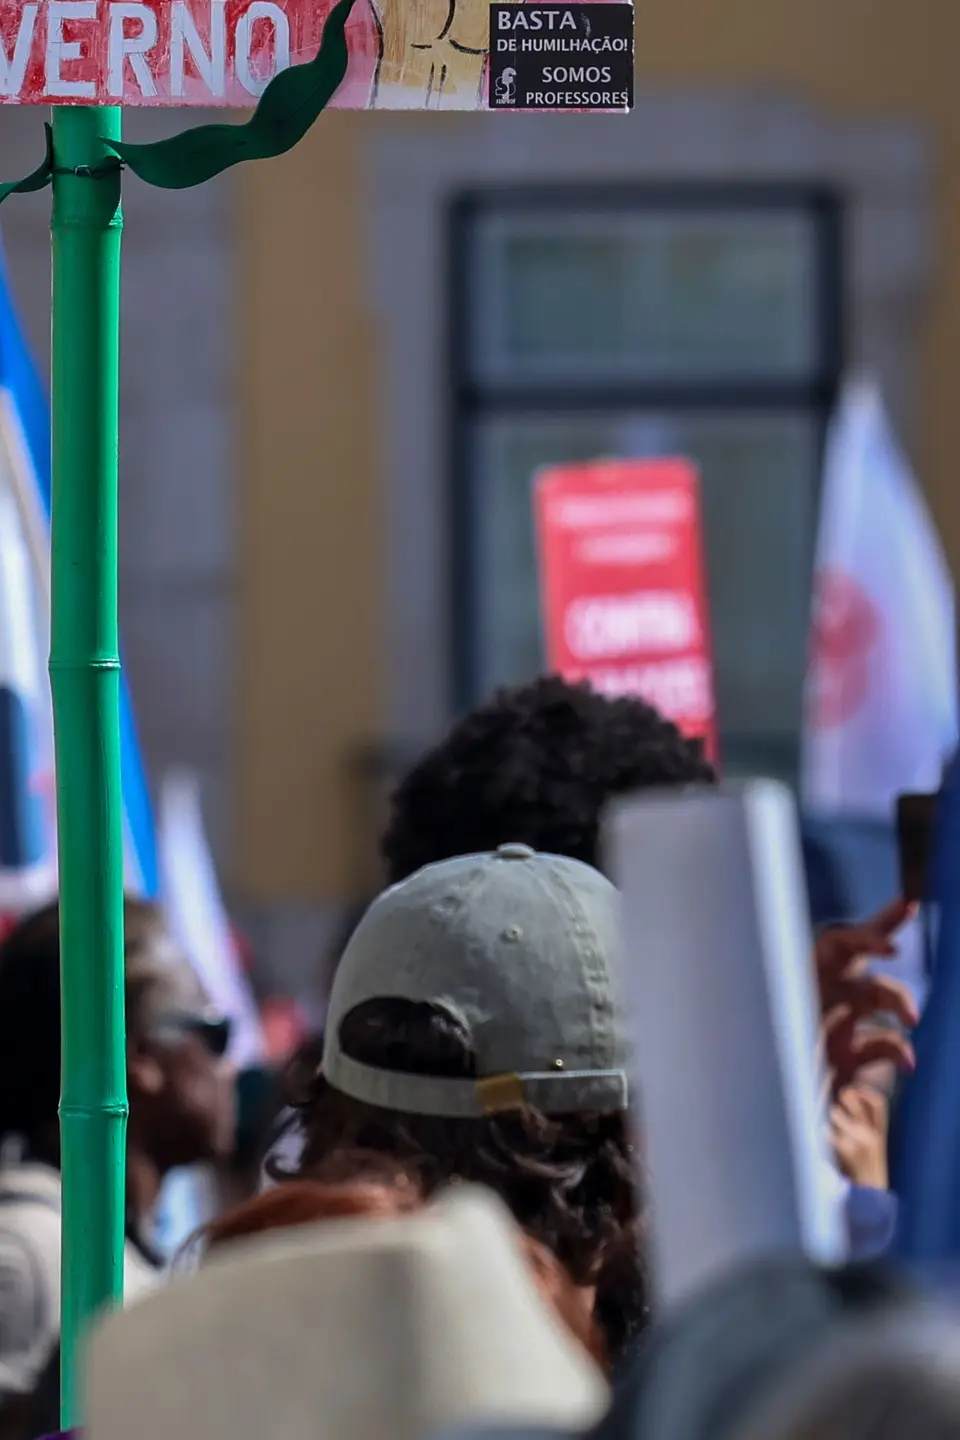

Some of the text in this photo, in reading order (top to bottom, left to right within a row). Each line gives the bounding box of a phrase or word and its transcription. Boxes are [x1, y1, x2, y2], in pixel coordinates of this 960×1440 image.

[497, 10, 578, 31] BASTA
[496, 35, 629, 55] DE HUMILHAÇÃO!
[541, 66, 612, 83] SOMOS
[525, 91, 629, 105] PROFESSORES
